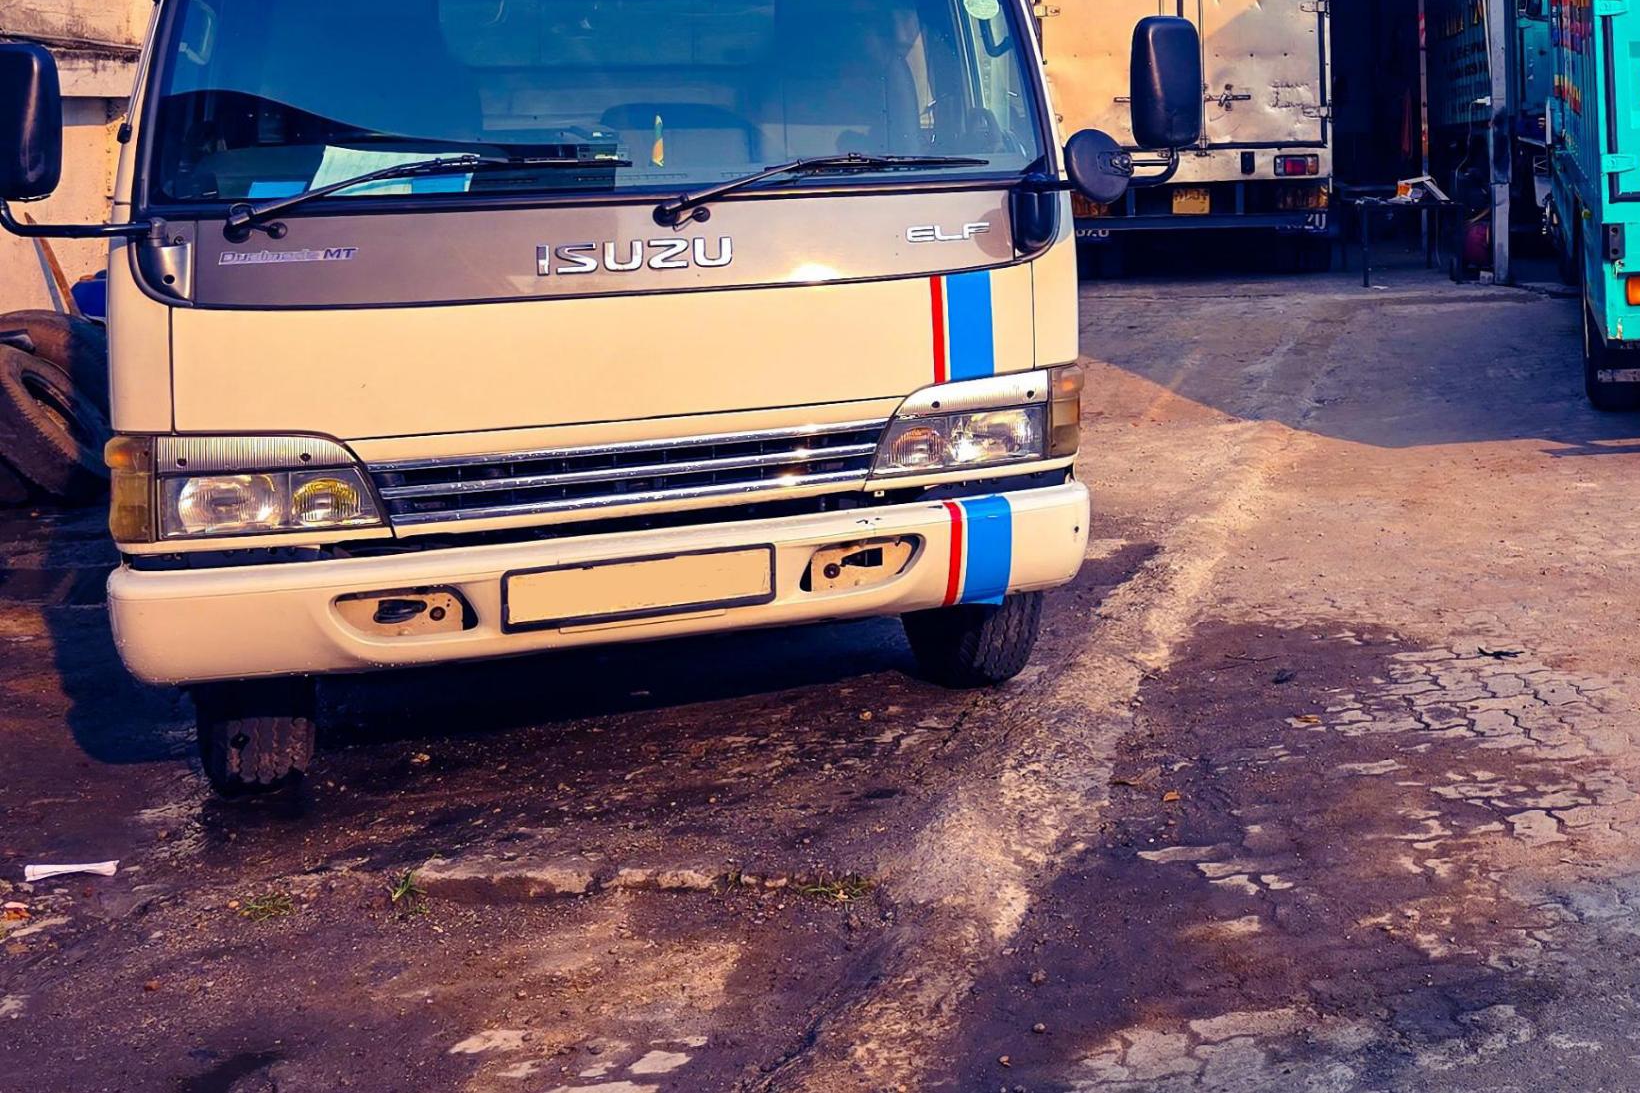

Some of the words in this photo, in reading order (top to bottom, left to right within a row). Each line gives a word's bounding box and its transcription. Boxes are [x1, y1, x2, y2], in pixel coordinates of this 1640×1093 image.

[905, 221, 990, 244] ELF
[323, 248, 357, 260] MT
[535, 236, 734, 276] ISUZU
